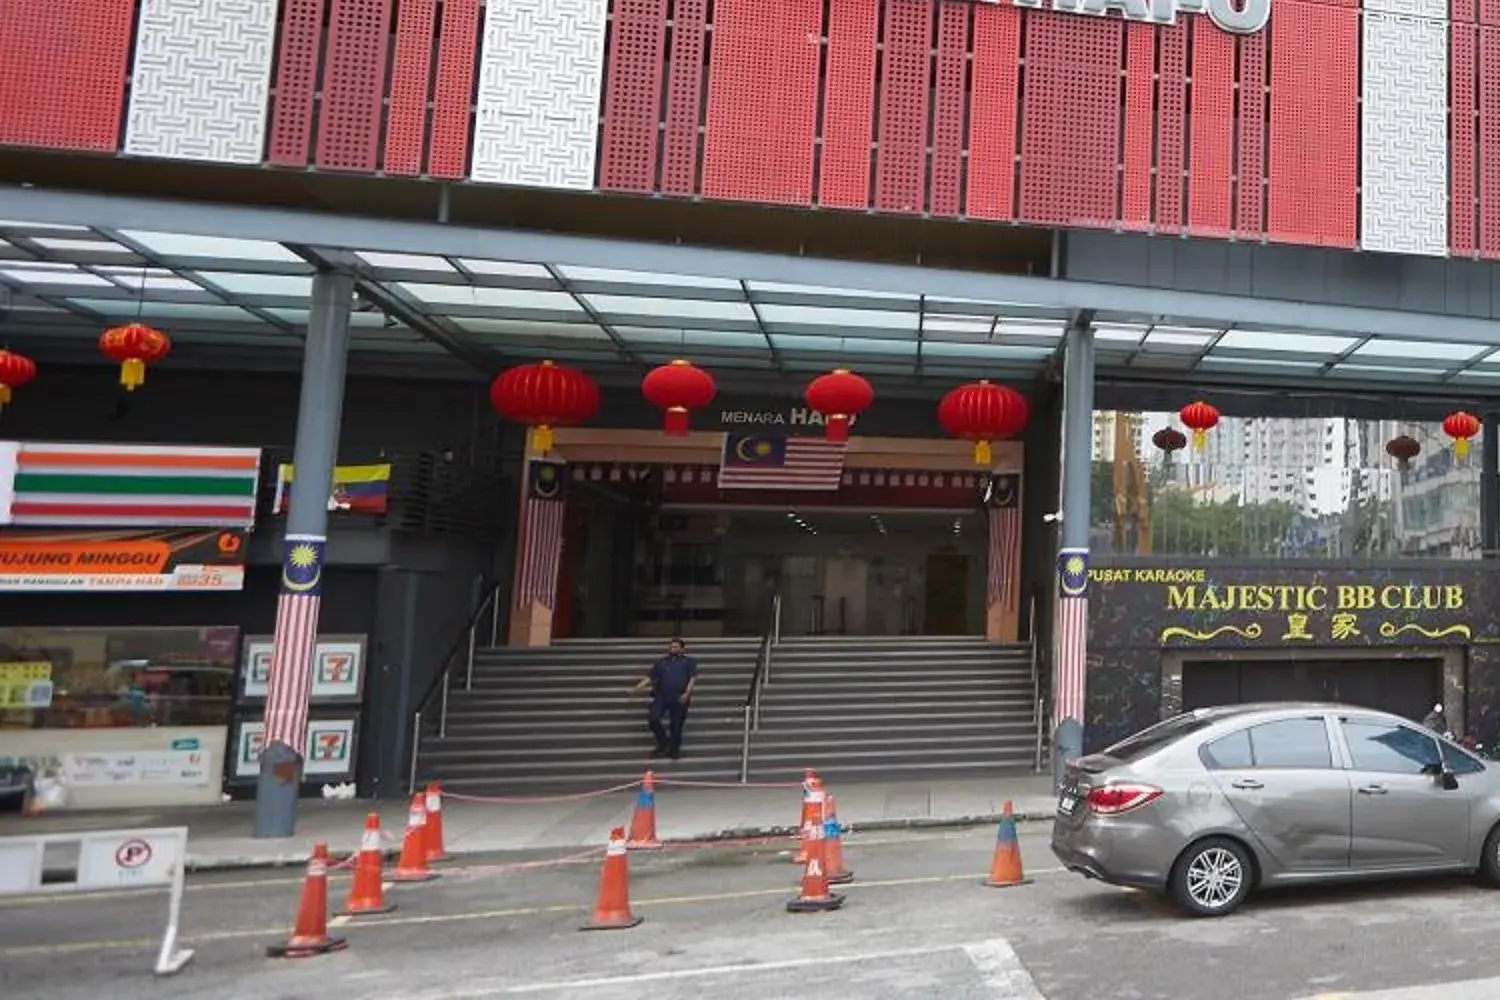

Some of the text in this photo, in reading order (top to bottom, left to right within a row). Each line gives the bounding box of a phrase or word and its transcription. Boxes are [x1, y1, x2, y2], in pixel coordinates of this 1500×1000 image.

[721, 410, 785, 425] MENARA
[0, 551, 161, 566] UJUNG MINGGU
[1087, 569, 1205, 583] PUSAT KARAOKE
[1167, 584, 1464, 610] MAJESTIC BB CLUB
[1281, 613, 1361, 641] 皇家
